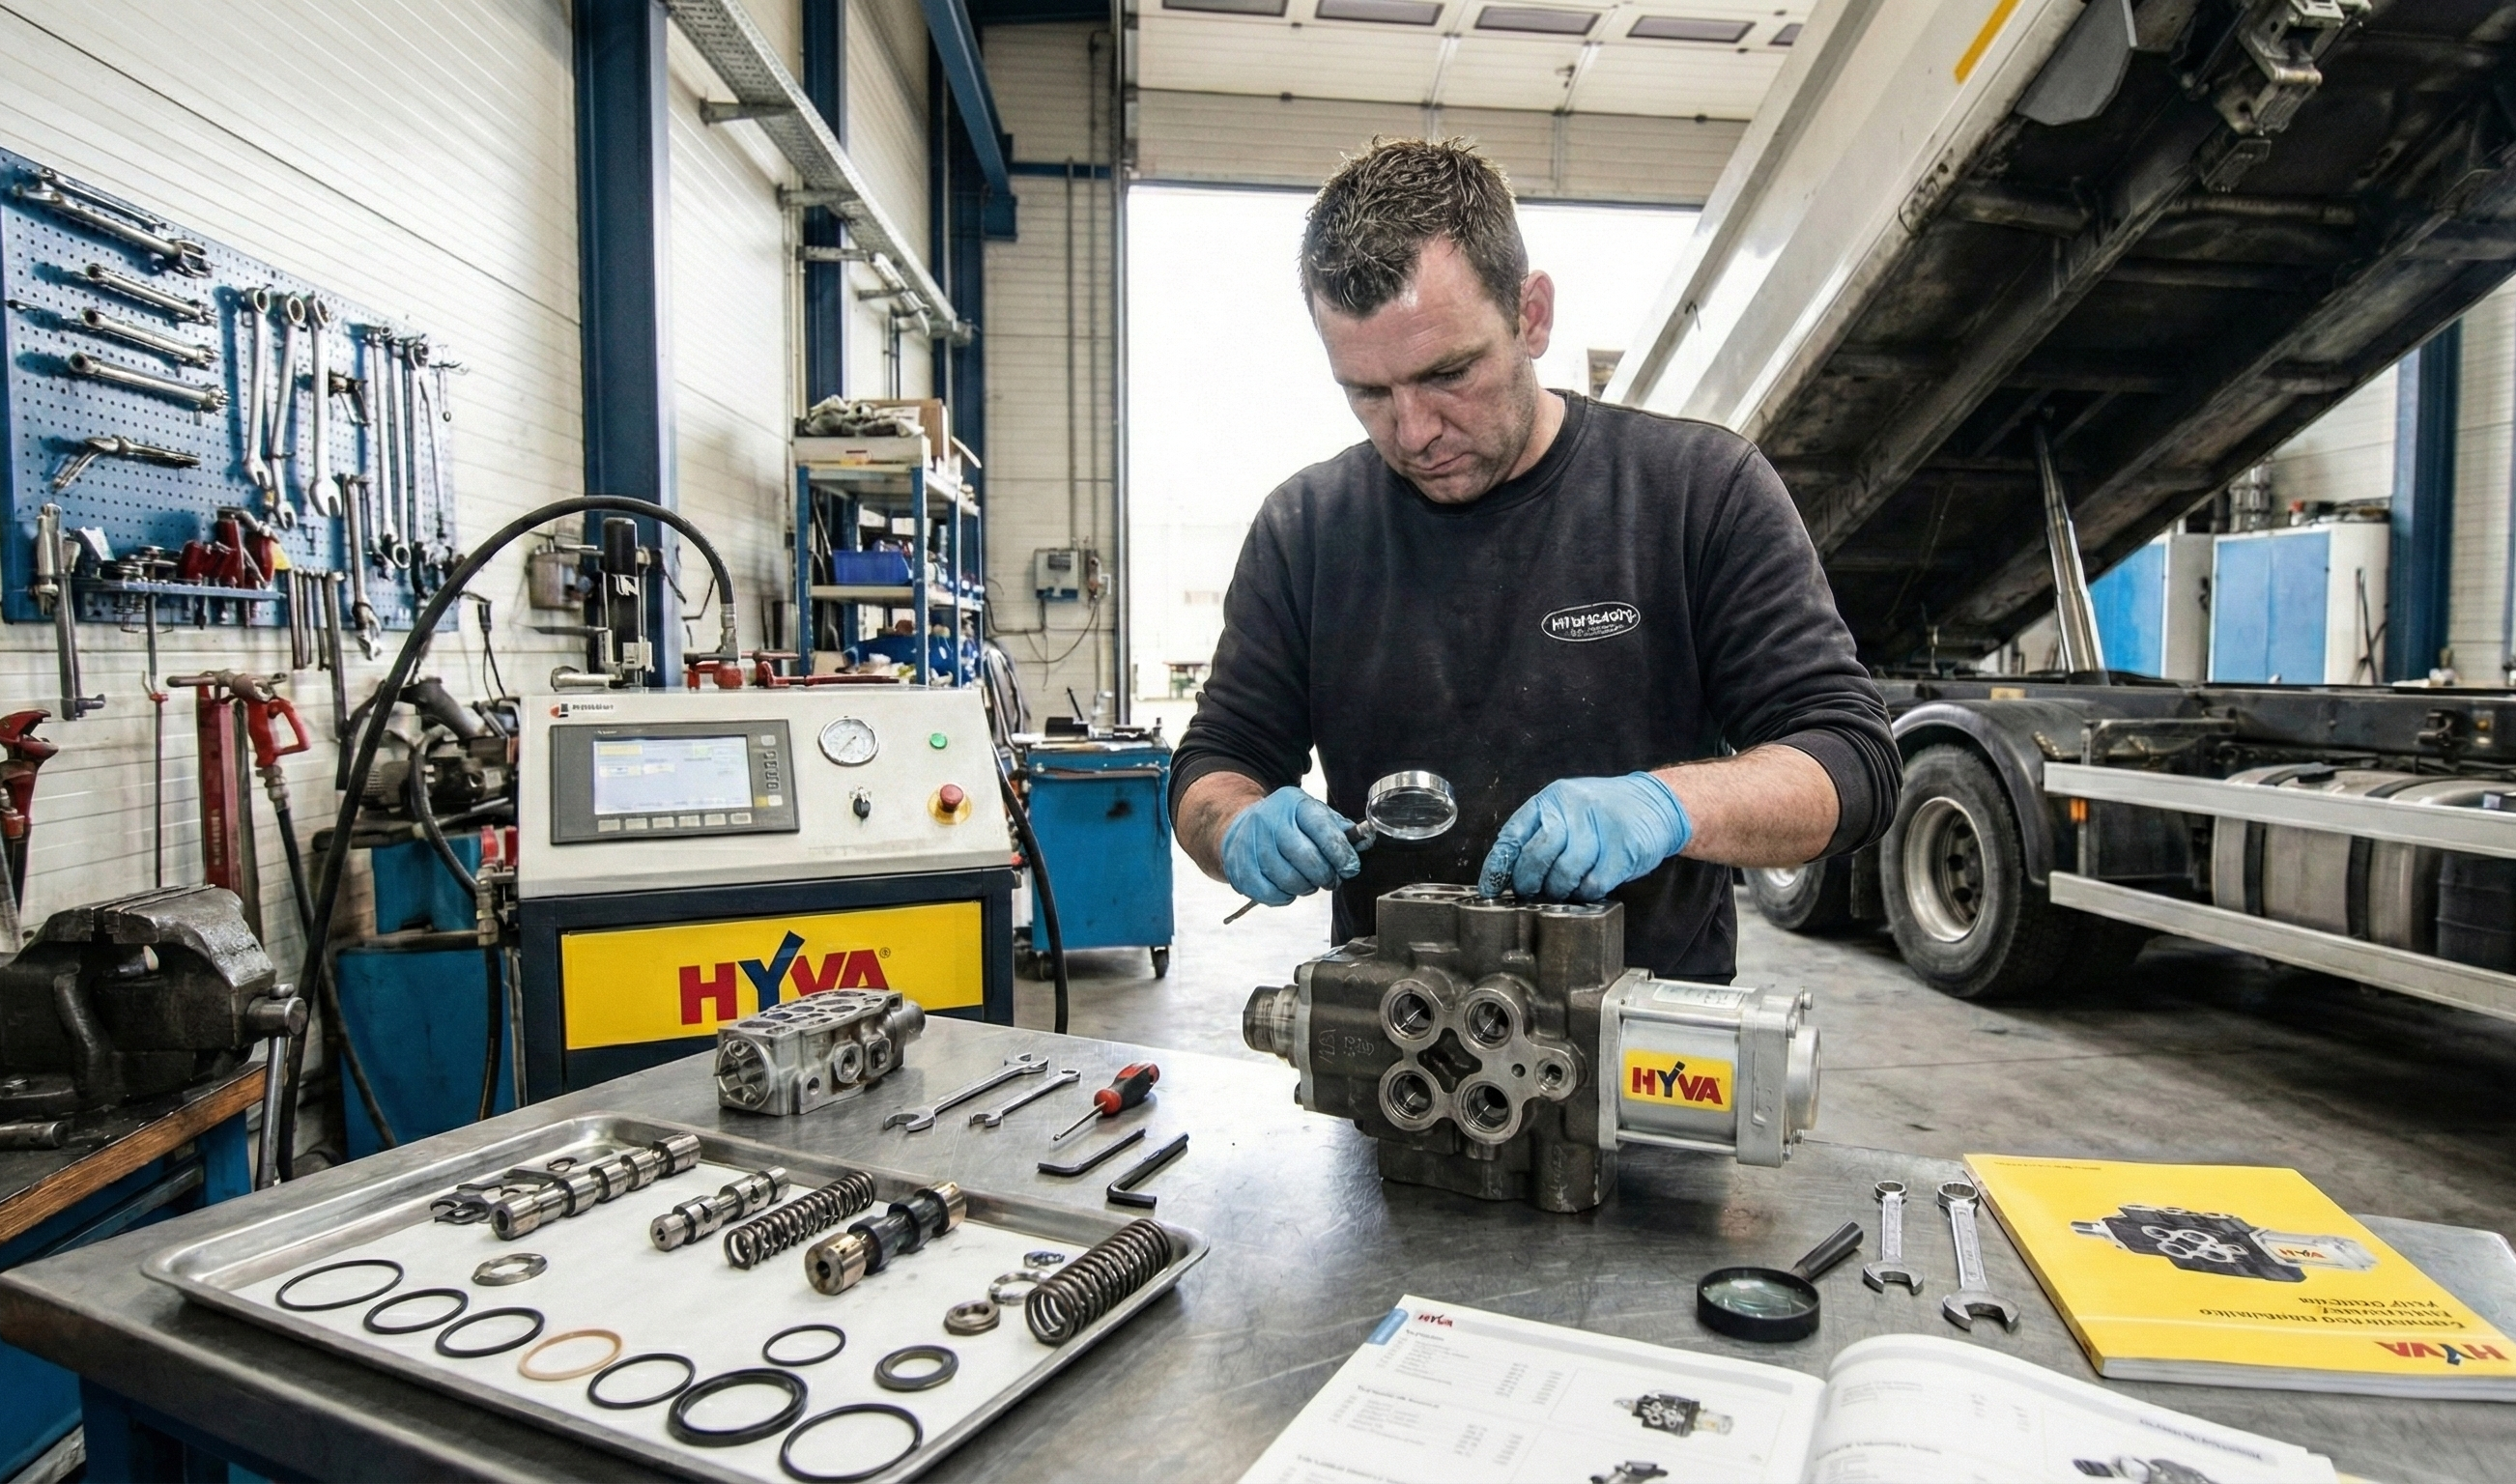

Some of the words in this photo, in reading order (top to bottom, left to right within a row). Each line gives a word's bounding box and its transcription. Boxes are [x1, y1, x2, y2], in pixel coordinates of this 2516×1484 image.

[679, 930, 889, 1025] HYVA
[1632, 1061, 1724, 1105] HYVA
[2374, 1341, 2508, 1366] HYVA
